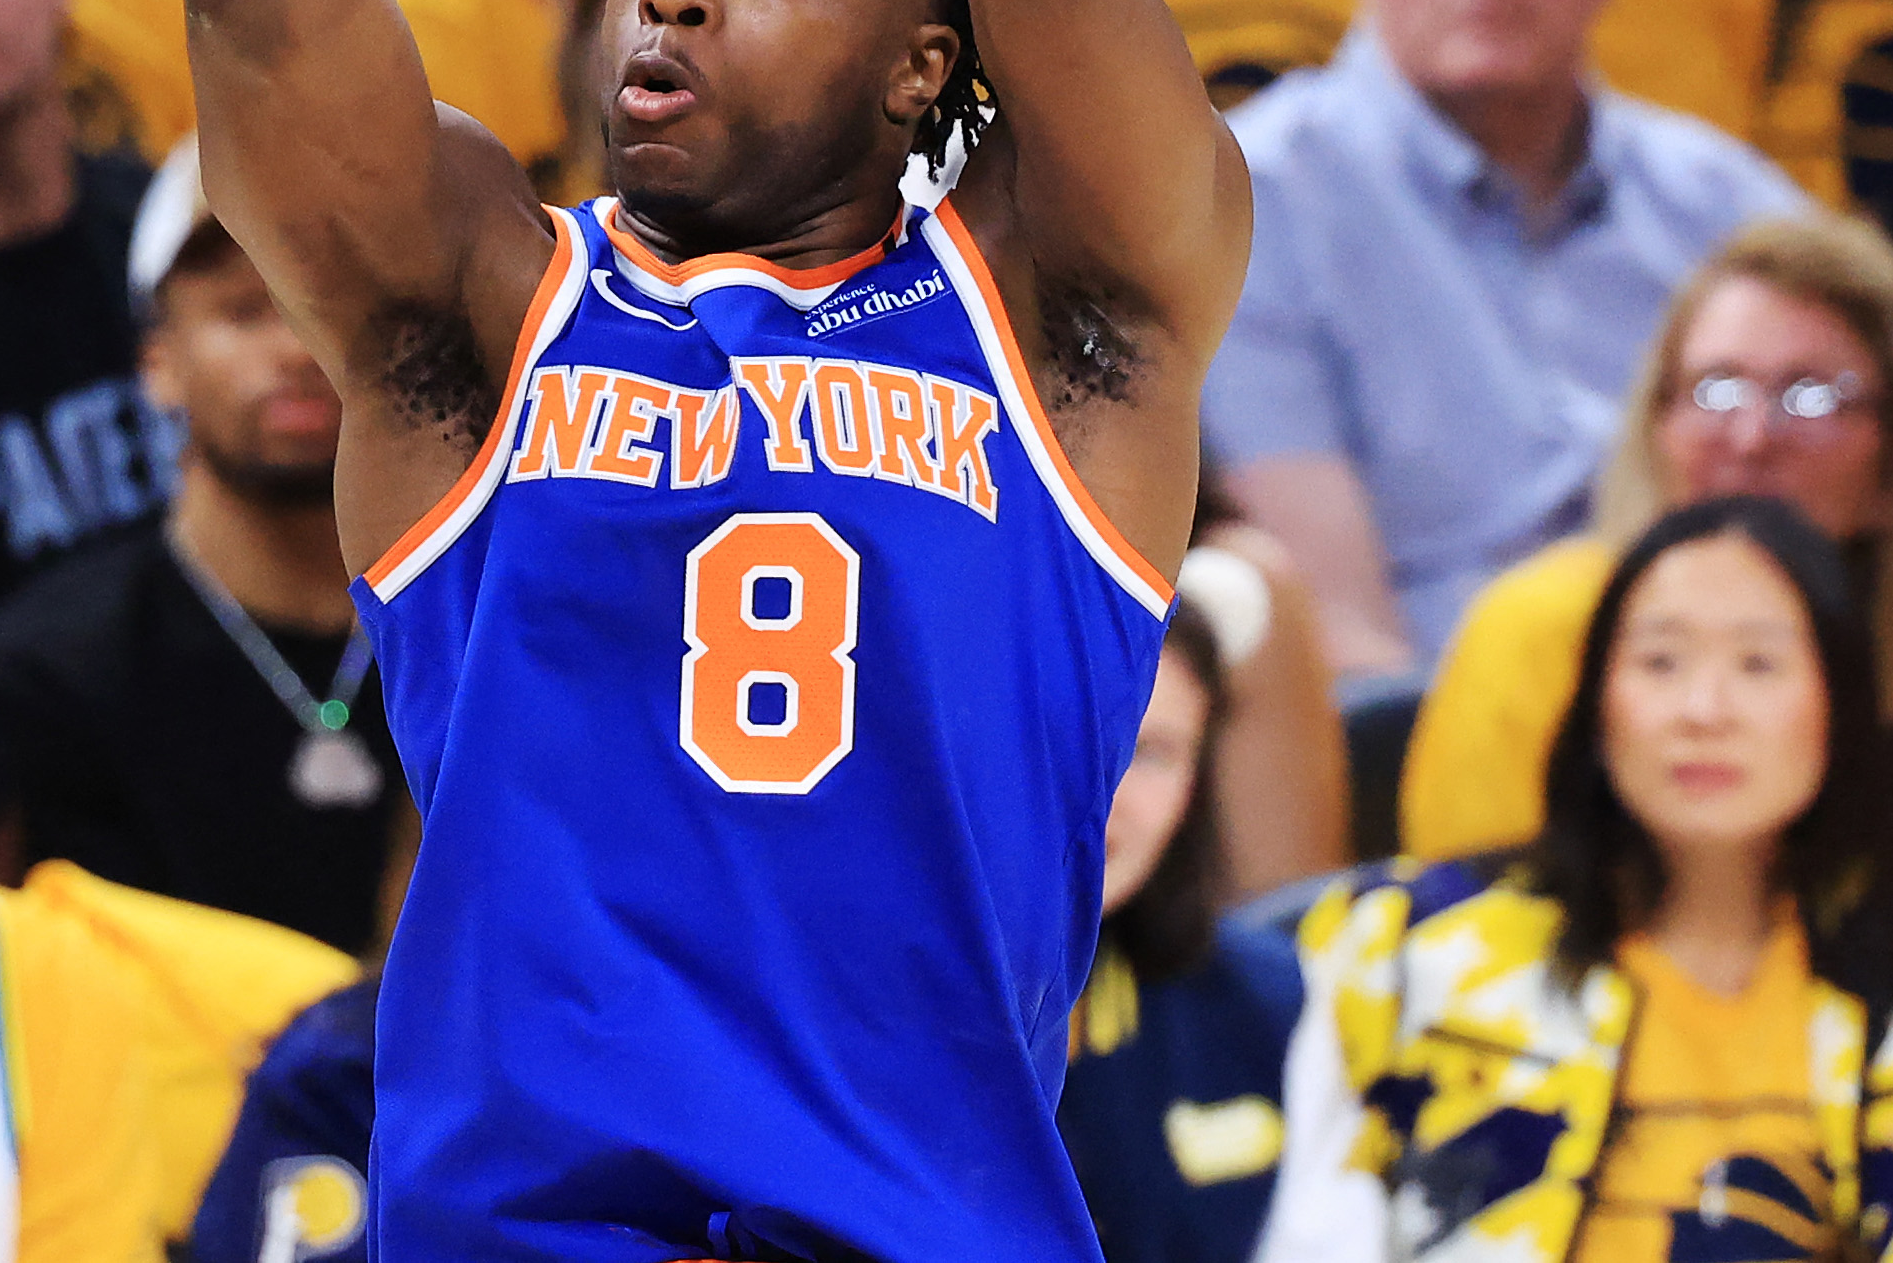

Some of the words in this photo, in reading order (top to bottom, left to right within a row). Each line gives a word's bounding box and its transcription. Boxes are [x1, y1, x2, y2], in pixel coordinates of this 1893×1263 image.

[804, 283, 876, 320] experience
[807, 304, 862, 337] abu
[863, 268, 946, 315] dhabi
[506, 364, 741, 490] NEW
[729, 355, 1000, 525] YORK
[679, 512, 861, 795] 8
